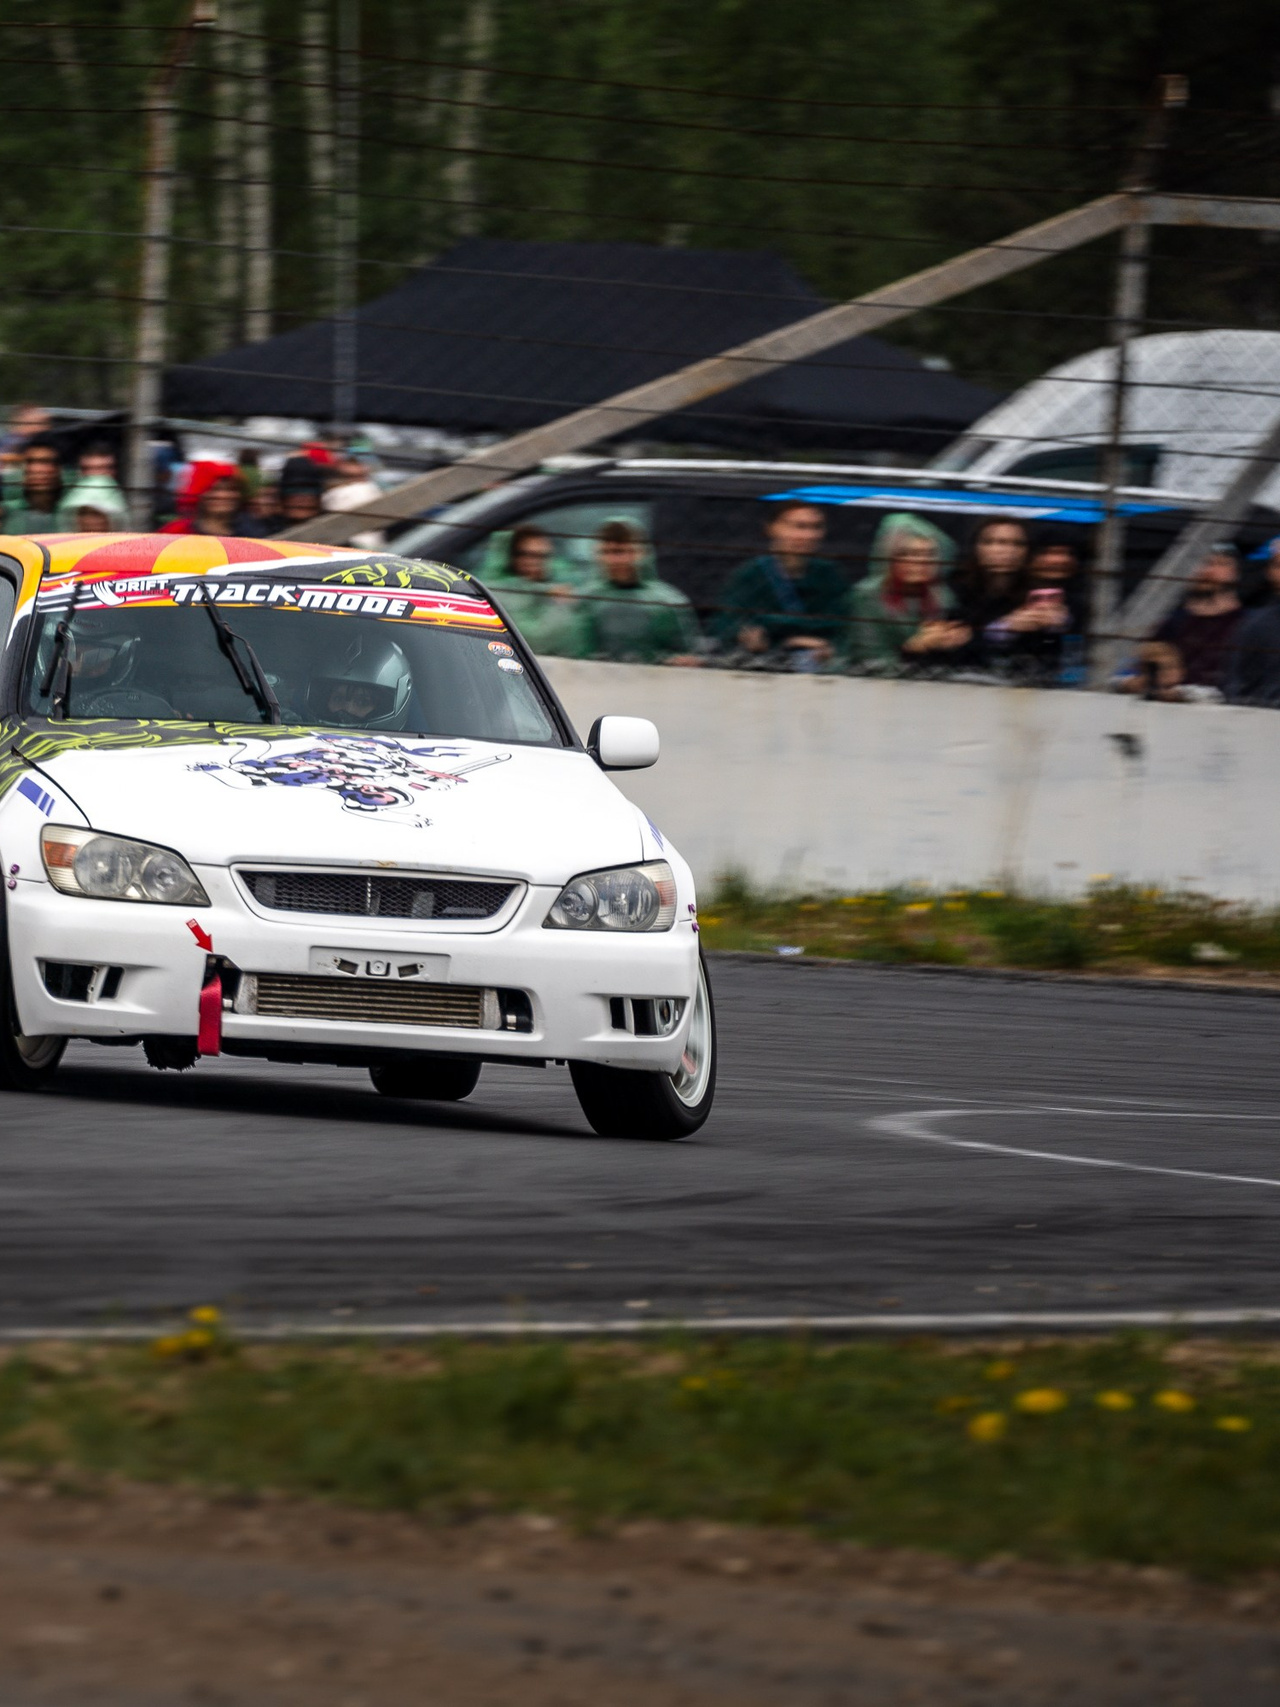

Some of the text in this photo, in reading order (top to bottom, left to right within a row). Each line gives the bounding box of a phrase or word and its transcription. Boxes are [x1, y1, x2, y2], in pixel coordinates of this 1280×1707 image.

[114, 579, 169, 593] DRIFT
[170, 583, 410, 617] TRACK MODE
